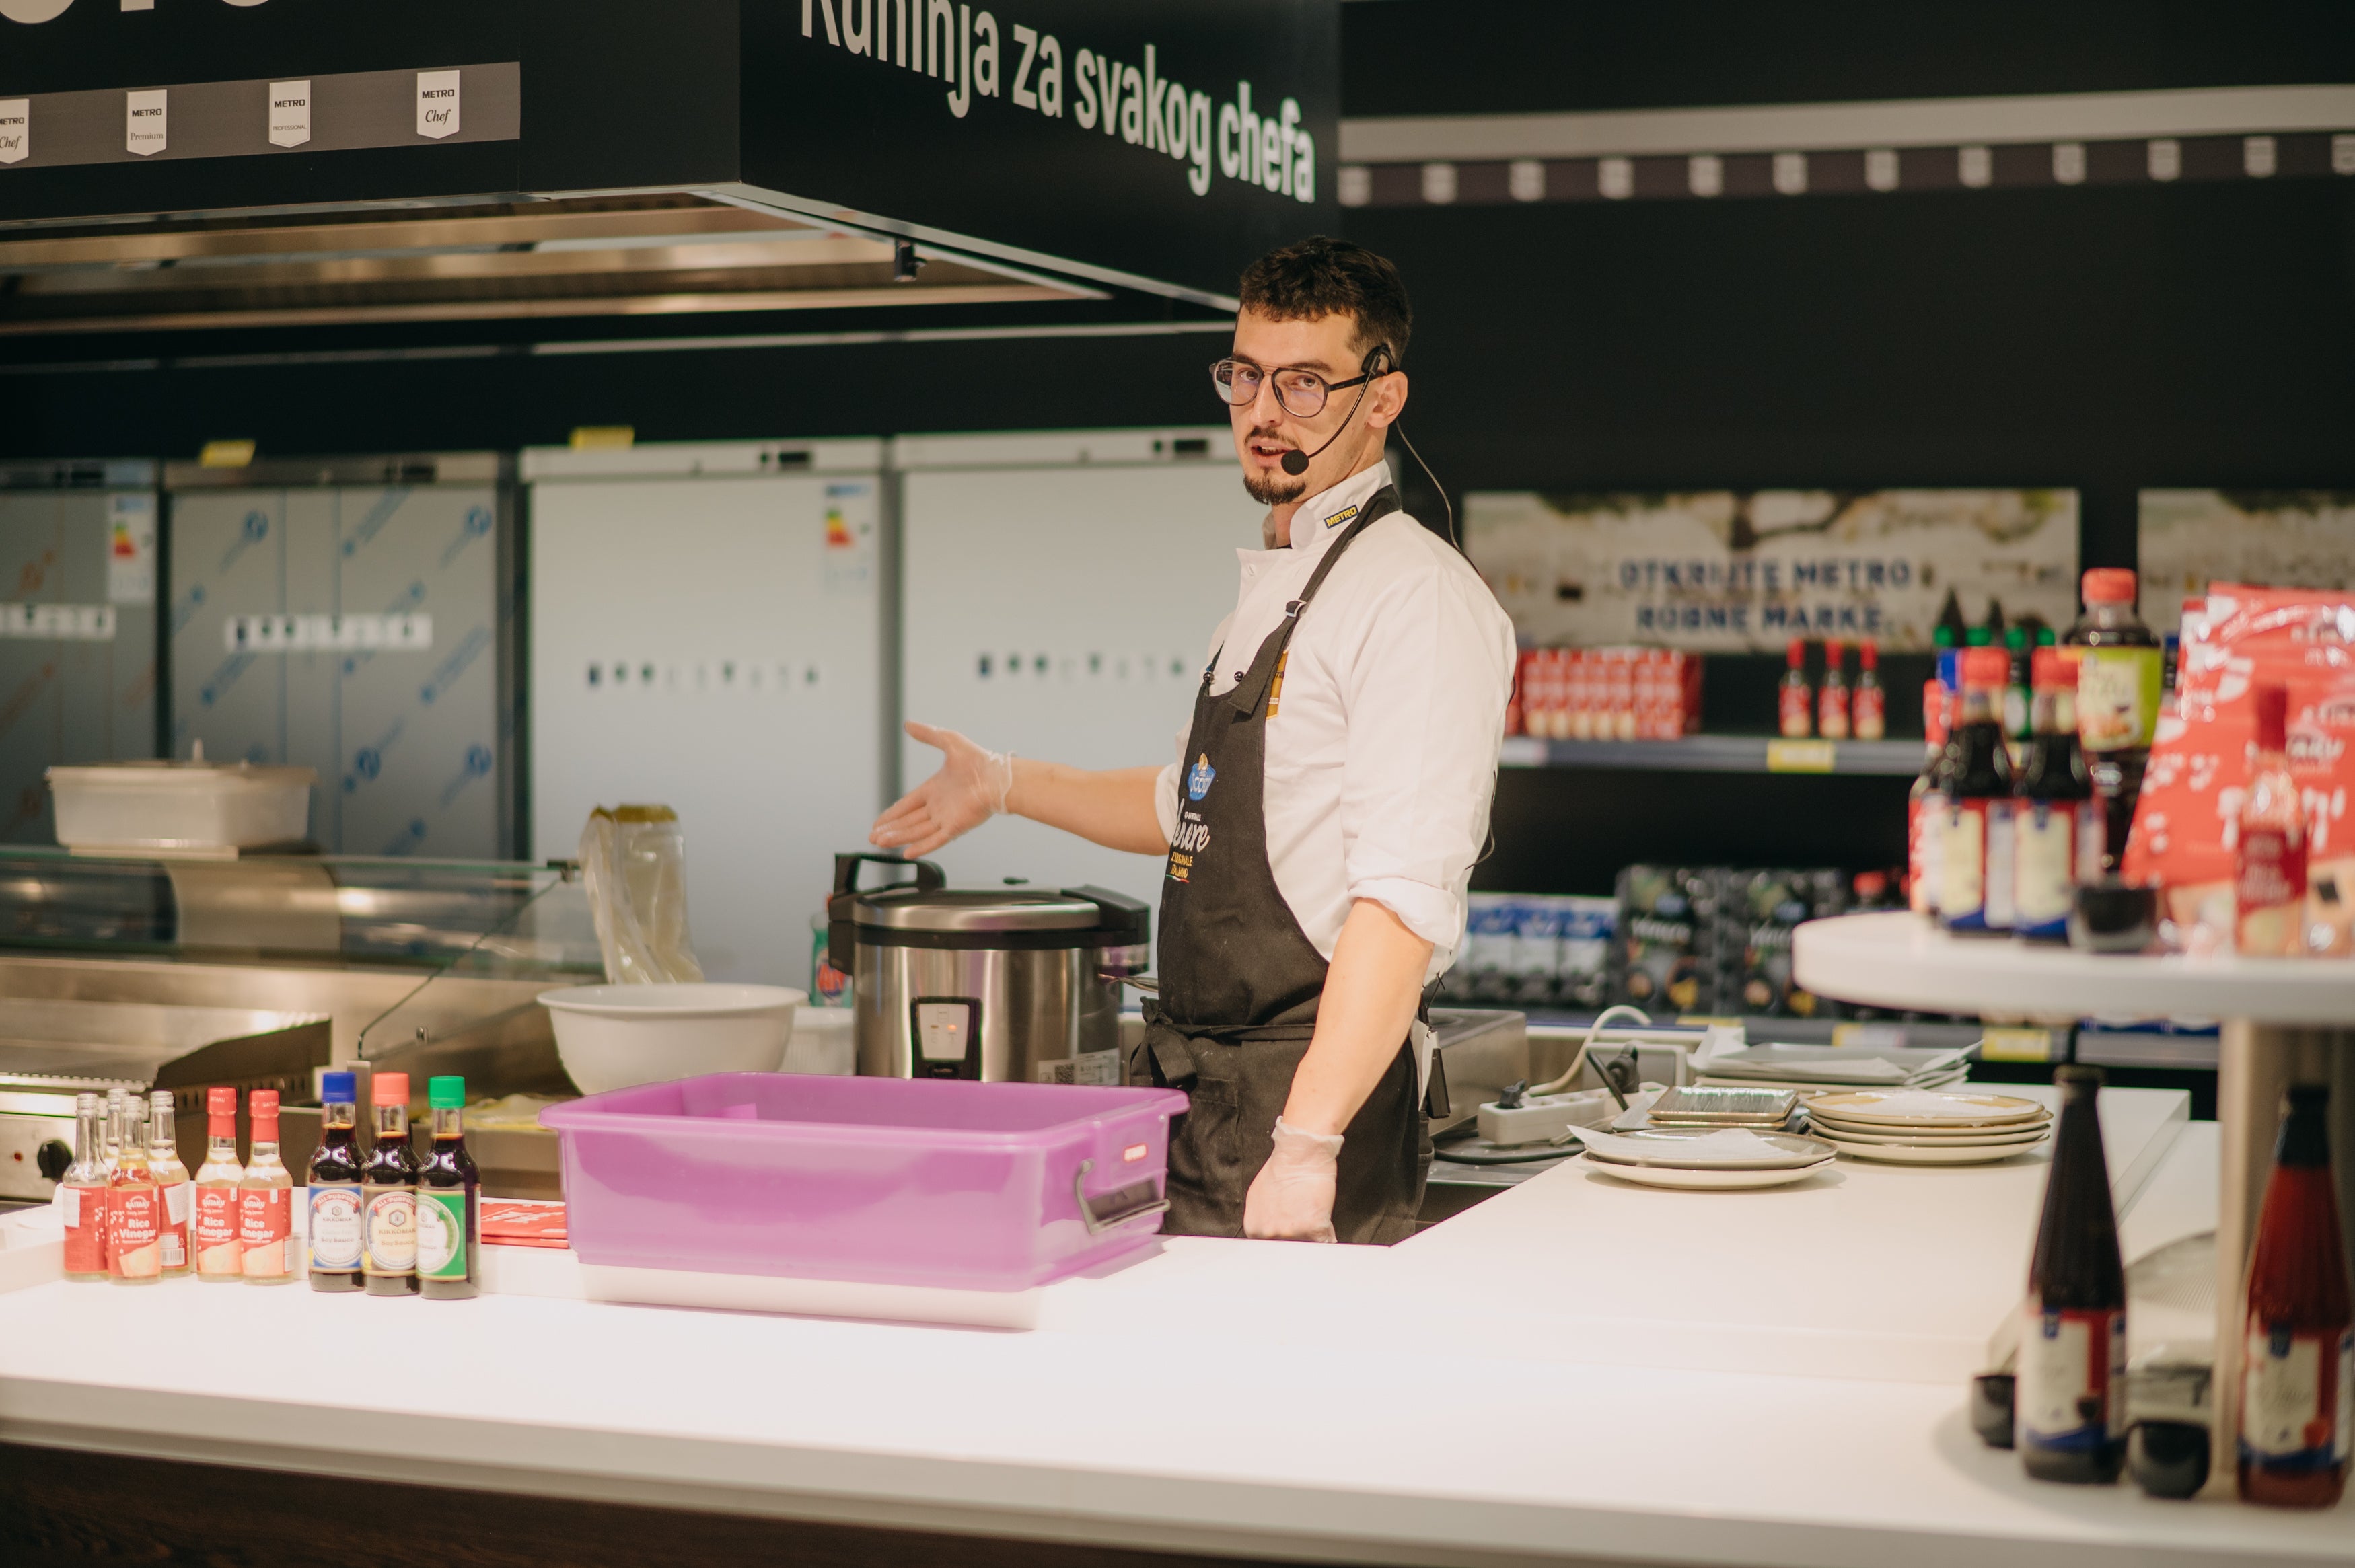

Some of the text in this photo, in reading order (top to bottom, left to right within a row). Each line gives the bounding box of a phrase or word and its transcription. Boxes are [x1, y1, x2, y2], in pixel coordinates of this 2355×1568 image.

[422, 89, 455, 99] METRO
[274, 99, 305, 108] METRO
[132, 108, 163, 117] METRO
[425, 109, 451, 126] Chef
[1013, 24, 1063, 118] za
[1074, 43, 1212, 196] svakog
[1219, 80, 1315, 203] chefa
[131, 132, 164, 141] Premium
[1326, 507, 1357, 527] METRO
[1792, 557, 1912, 589] METRO
[128, 1218, 150, 1228] Rice
[203, 1216, 225, 1226] Rice
[244, 1218, 265, 1228] Rice
[119, 1228, 157, 1240] Vinegar
[198, 1226, 233, 1238] Vinegar
